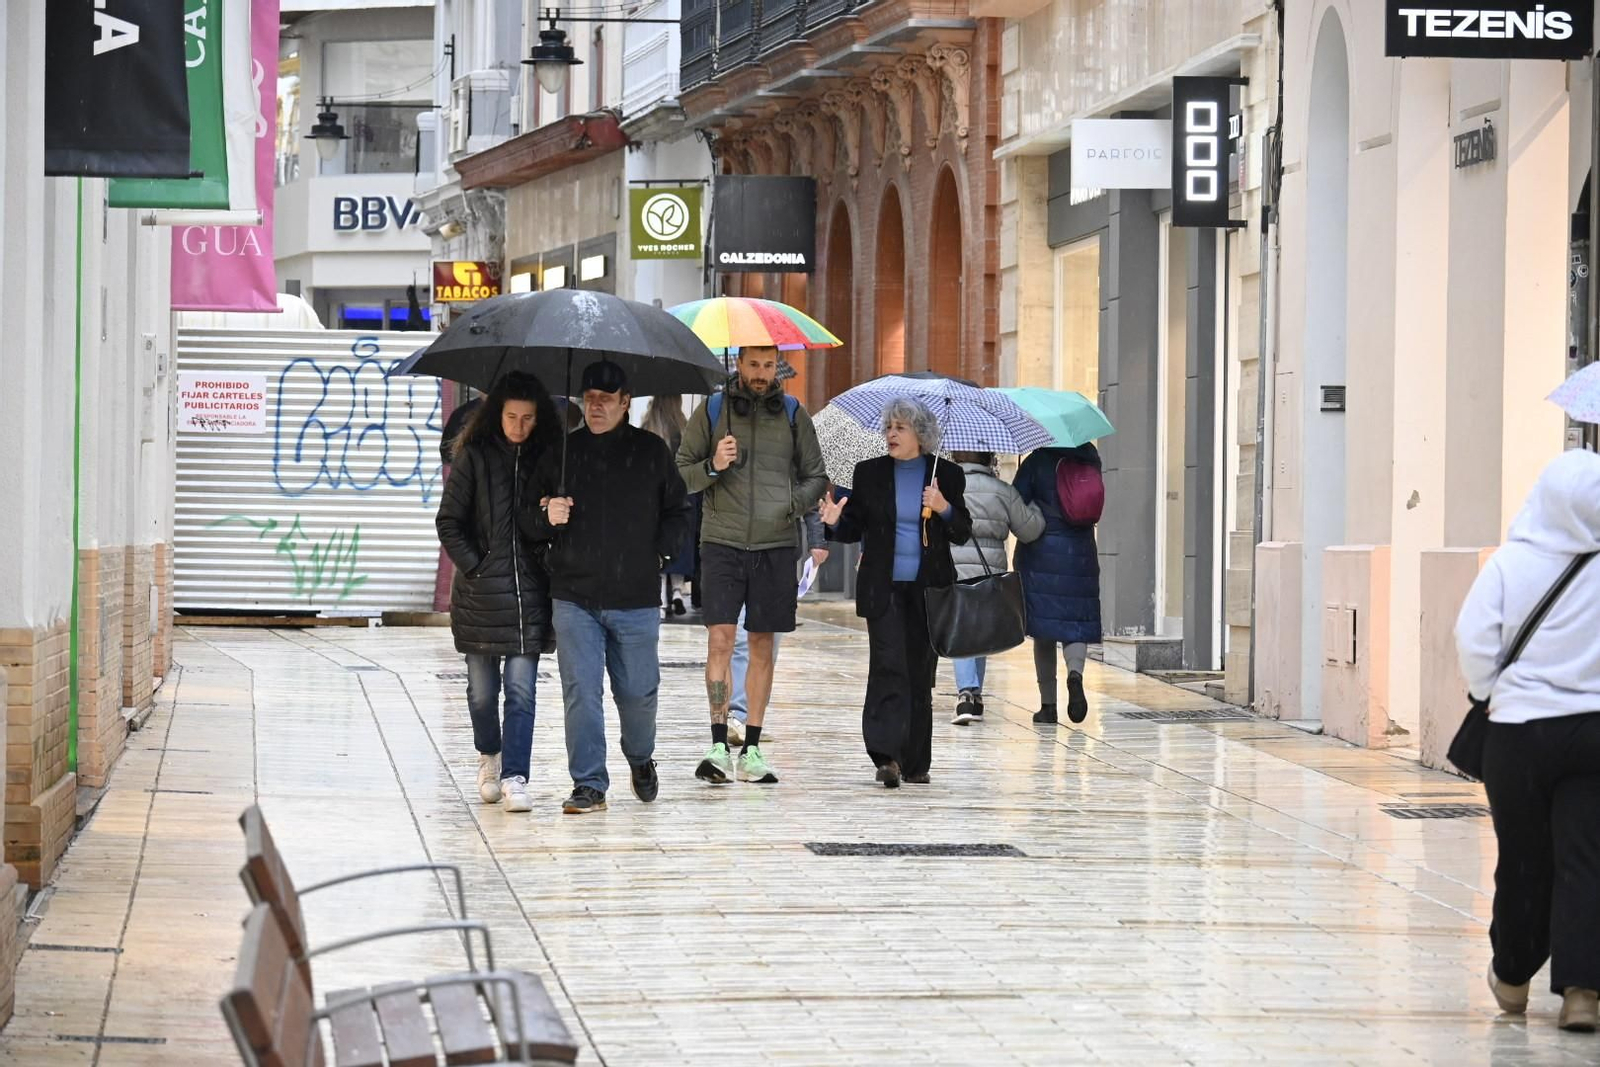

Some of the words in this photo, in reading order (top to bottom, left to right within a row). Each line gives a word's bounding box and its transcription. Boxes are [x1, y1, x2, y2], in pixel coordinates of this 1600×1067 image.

[182, 225, 264, 257] GUA
[660, 243, 695, 251] ROCHER
[719, 253, 806, 265] CALZEDONIA
[436, 286, 498, 298] TABACOS
[195, 381, 250, 390] PROHIBIDO
[181, 391, 209, 399] FIJAR
[212, 392, 263, 400] CARTELES
[184, 402, 260, 410] PUBLICITARIOS
